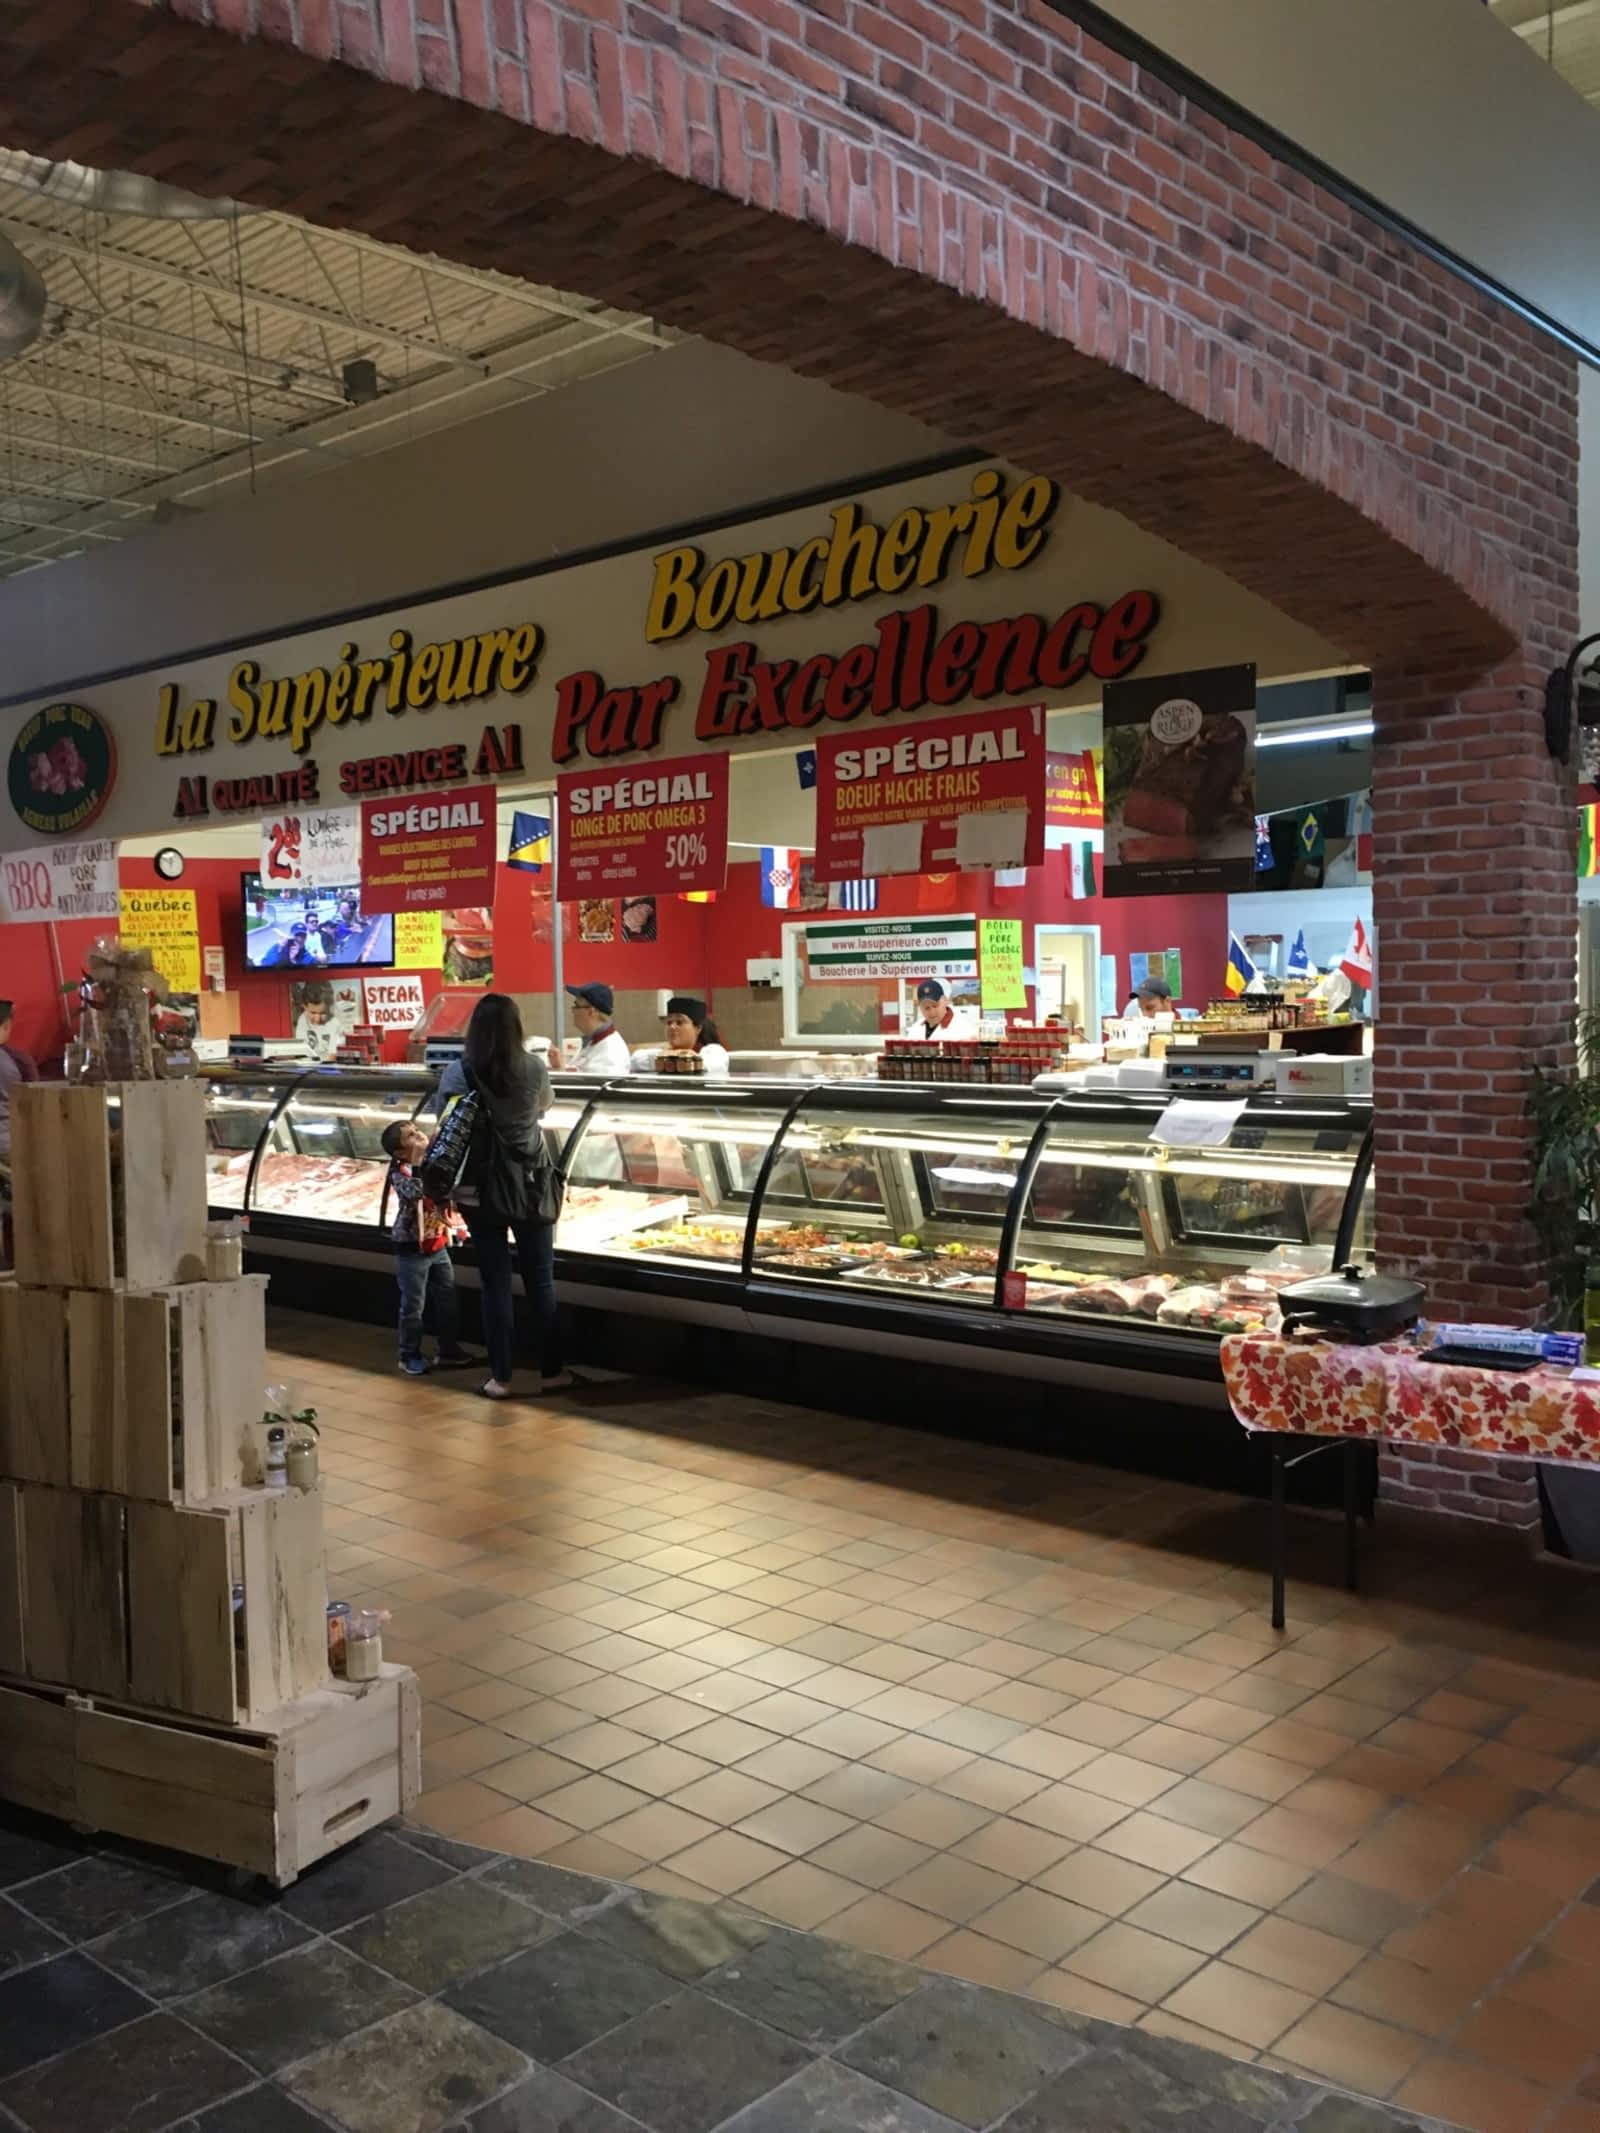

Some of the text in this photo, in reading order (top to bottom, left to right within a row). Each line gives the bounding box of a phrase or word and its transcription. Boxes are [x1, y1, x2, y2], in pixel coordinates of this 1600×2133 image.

[646, 471, 1055, 643] Boucherie
[156, 623, 541, 756] La Supérieure
[553, 590, 1156, 764] Par Excellence
[835, 728, 1025, 781] SPÉCIAL
[213, 761, 318, 811] QUALITÉ
[340, 745, 464, 794] SERVICE
[570, 772, 713, 814] SPÉCIAL
[836, 770, 980, 811] BOEUF HACHÉ FRAIS
[370, 801, 484, 837] SPÉCIAL
[570, 805, 706, 838] LONGE DE PORC OMEGA 3
[665, 832, 707, 869] 50%
[864, 925, 912, 934] VISITEZ-NOUS
[819, 962, 937, 977] Boucherie la Supérieure
[367, 985, 420, 1004] STEAK
